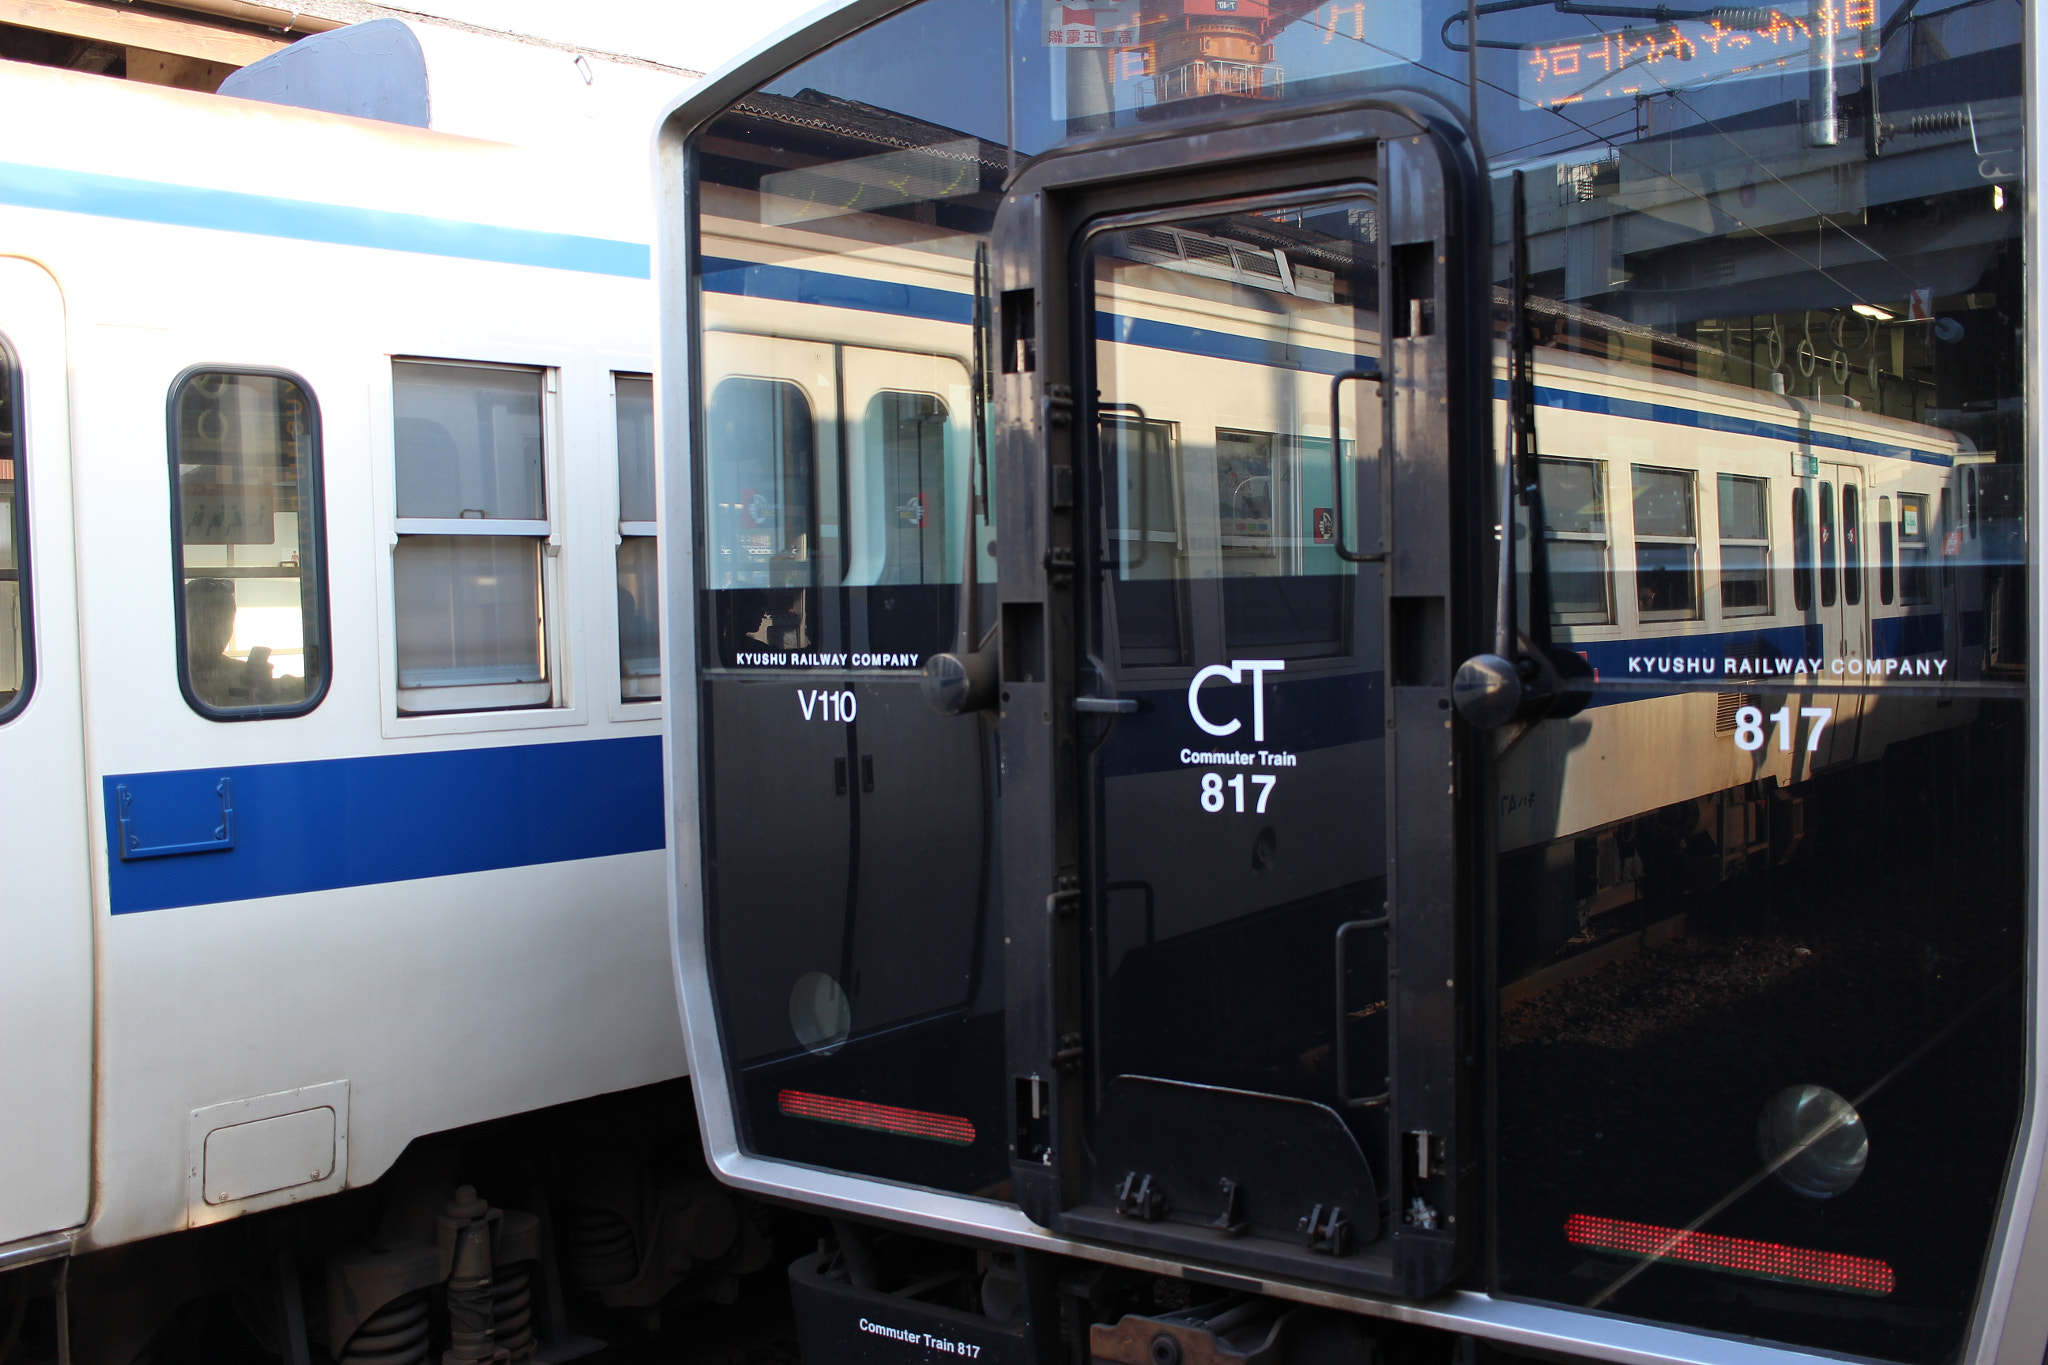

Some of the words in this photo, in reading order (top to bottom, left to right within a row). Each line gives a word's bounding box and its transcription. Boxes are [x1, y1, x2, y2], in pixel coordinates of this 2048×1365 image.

[736, 652, 787, 666] KYUSHU
[790, 653, 848, 667] RAILWAY
[851, 653, 919, 668] COMPANY
[1628, 656, 1716, 674] KYUSHU
[1724, 658, 1823, 675] RAILWAY
[1830, 658, 1949, 676] COMPANY
[797, 689, 857, 723] V110
[1188, 659, 1286, 742] CT
[1734, 706, 1833, 752] 817
[1180, 748, 1255, 767] Commuter
[1258, 749, 1297, 768] Train
[1200, 772, 1278, 814] 817
[859, 1318, 921, 1344] Commuter
[923, 1332, 955, 1353] Train
[957, 1341, 981, 1359] 817
